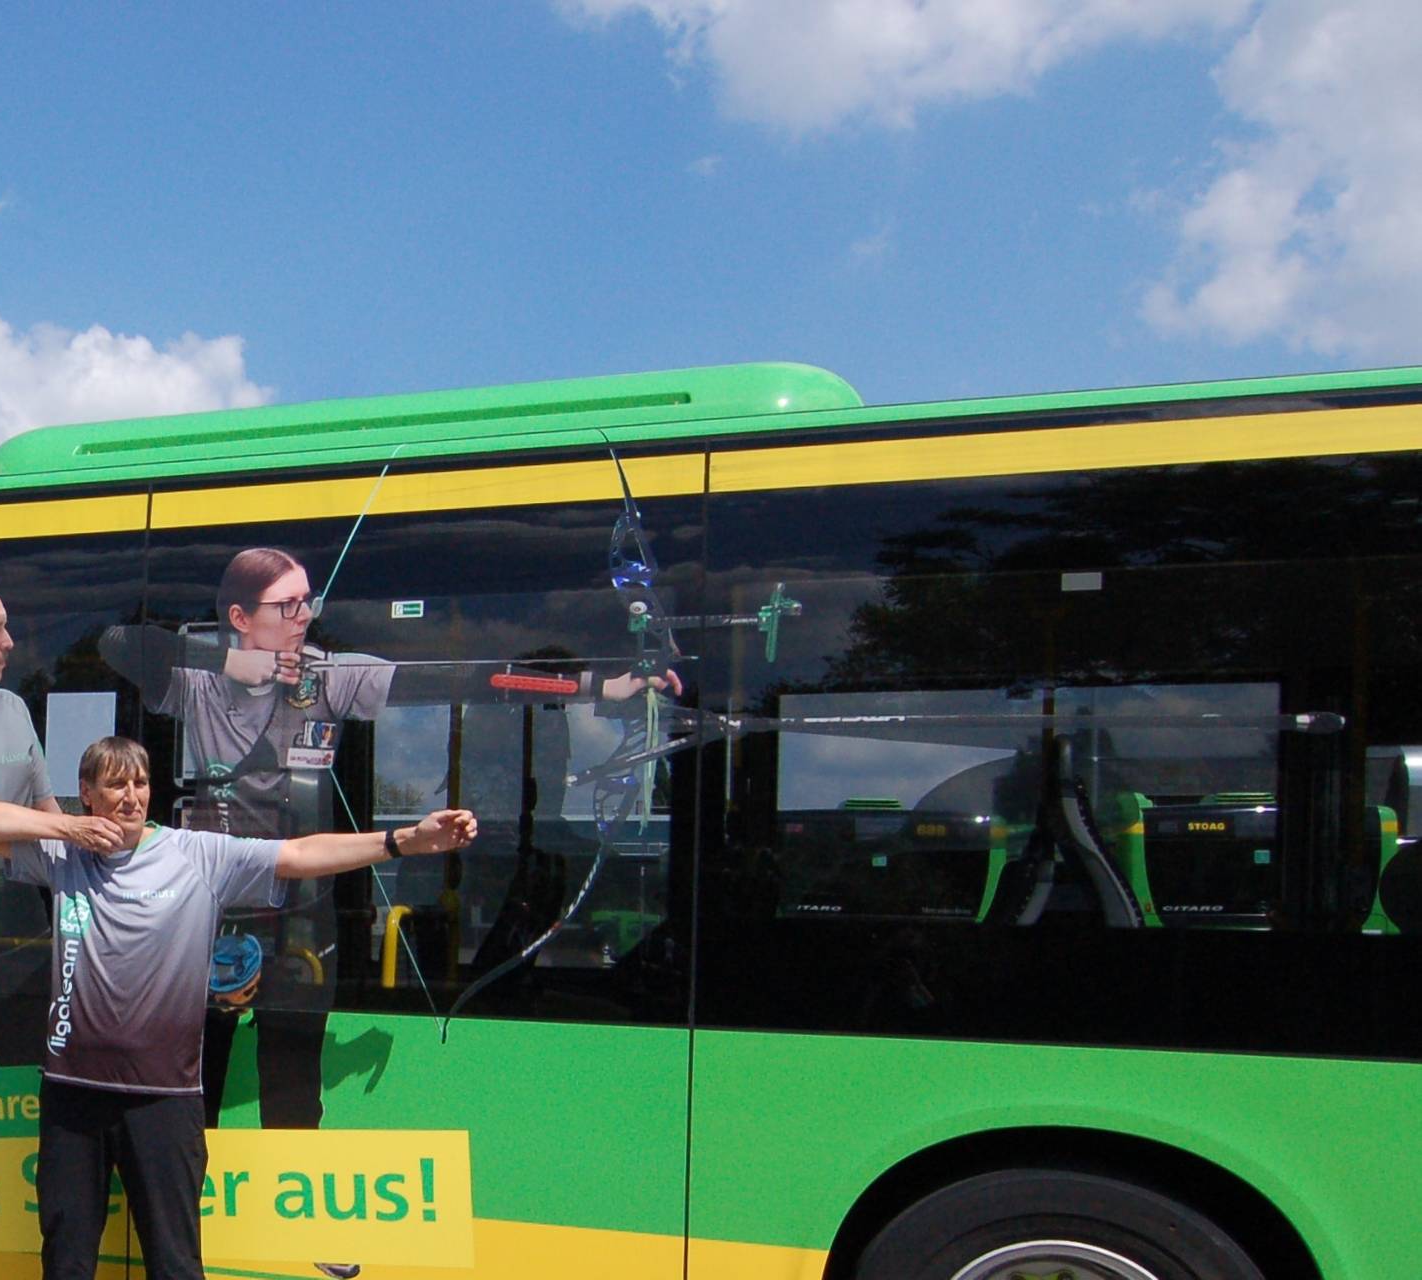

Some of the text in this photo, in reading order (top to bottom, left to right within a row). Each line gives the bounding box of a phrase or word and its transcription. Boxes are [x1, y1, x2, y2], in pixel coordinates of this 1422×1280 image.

[1187, 822, 1226, 831] STOAG
[795, 904, 843, 913] ITARO
[1162, 904, 1224, 912] CITARO
[50, 938, 79, 1048] ligateam
[274, 1157, 437, 1223] aus!
